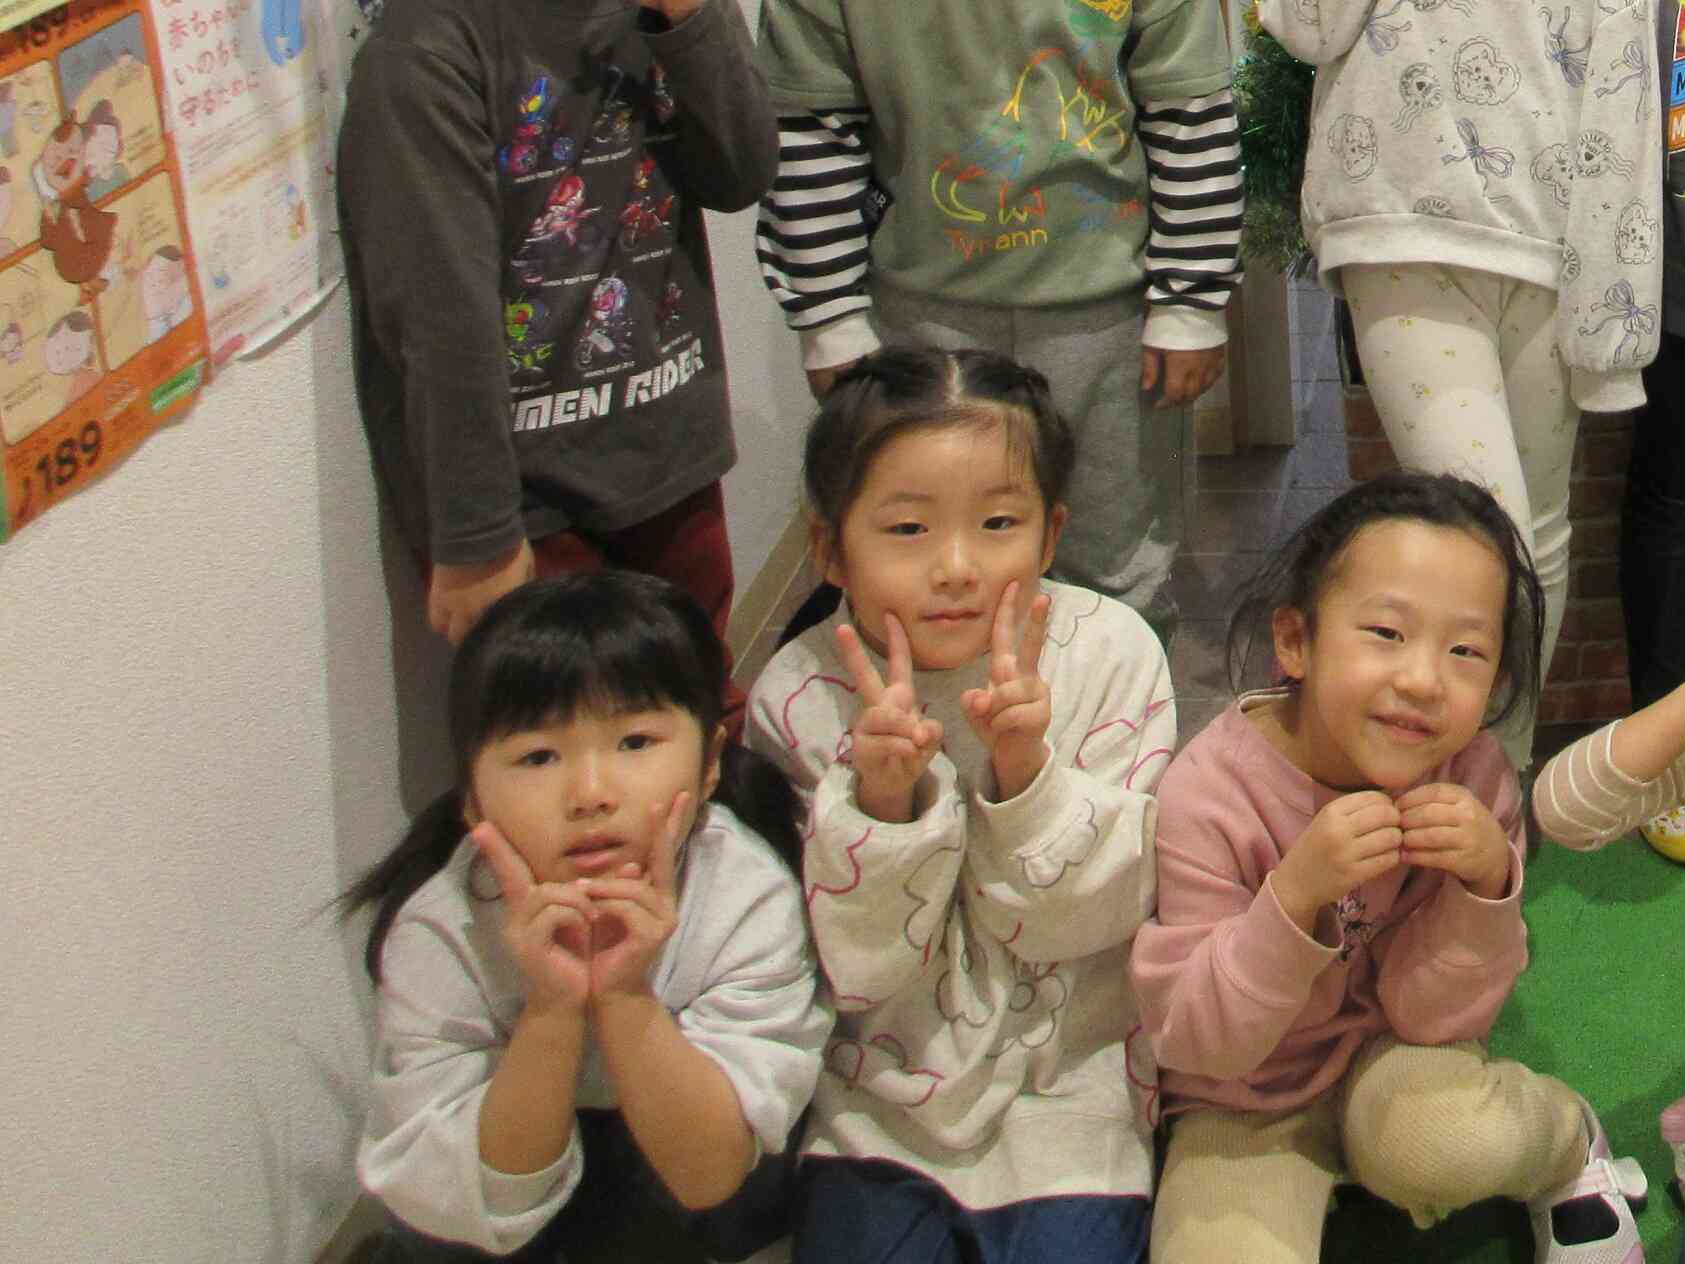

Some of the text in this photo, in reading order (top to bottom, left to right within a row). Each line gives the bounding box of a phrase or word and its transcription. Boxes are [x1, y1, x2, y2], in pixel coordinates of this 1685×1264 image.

[511, 337, 705, 432] MEN RIDER
[36, 419, 103, 496] 189
